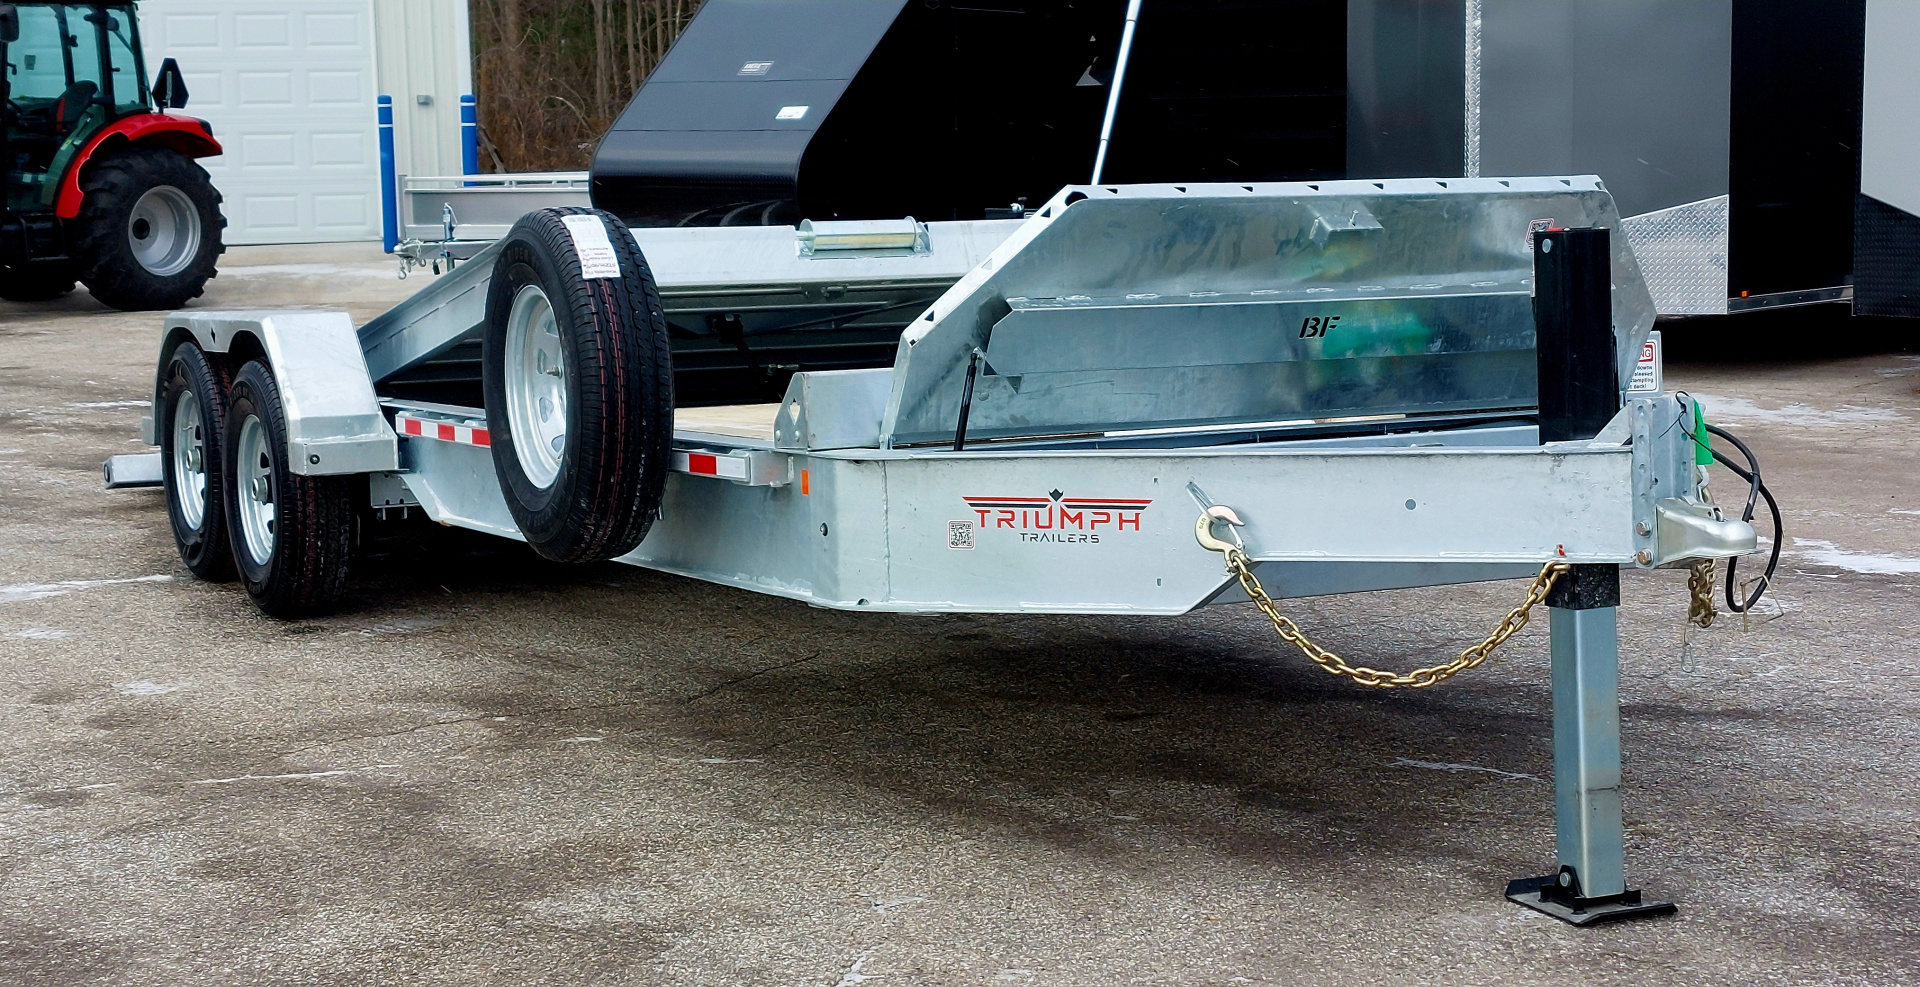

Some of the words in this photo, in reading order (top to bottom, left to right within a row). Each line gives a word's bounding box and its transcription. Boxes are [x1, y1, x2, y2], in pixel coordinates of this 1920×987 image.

[1299, 316, 1341, 338] BF
[974, 505, 1141, 531] TRIUMPH
[1019, 532, 1100, 544] TRAILERS
